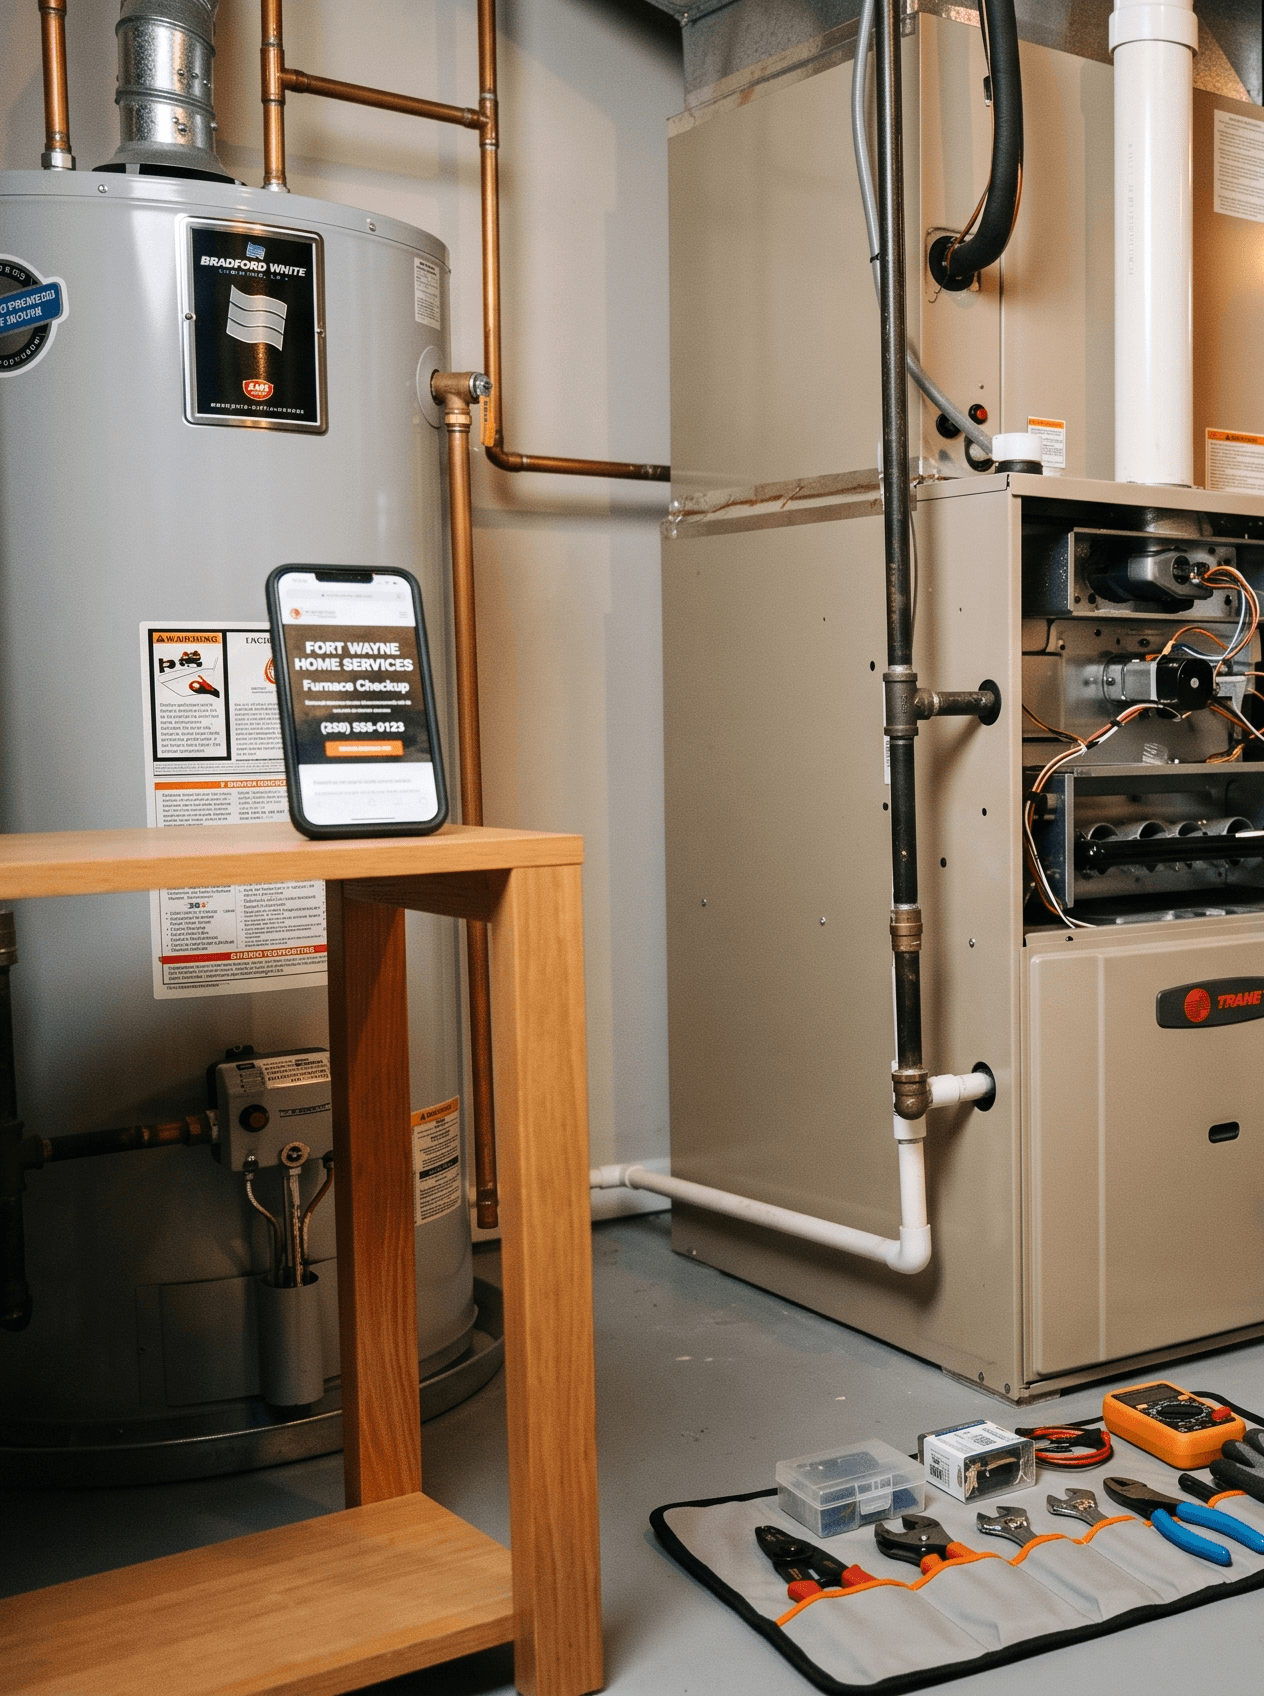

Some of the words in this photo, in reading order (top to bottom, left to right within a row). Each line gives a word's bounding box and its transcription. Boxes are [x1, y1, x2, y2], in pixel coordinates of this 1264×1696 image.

[201, 255, 267, 272] BRADFORD
[305, 641, 345, 655] FORT
[347, 641, 400, 655] WAYNE
[294, 658, 341, 671] HOME
[343, 658, 414, 672] SERVICES
[303, 679, 354, 692] Furnace
[355, 679, 410, 695] Checkup
